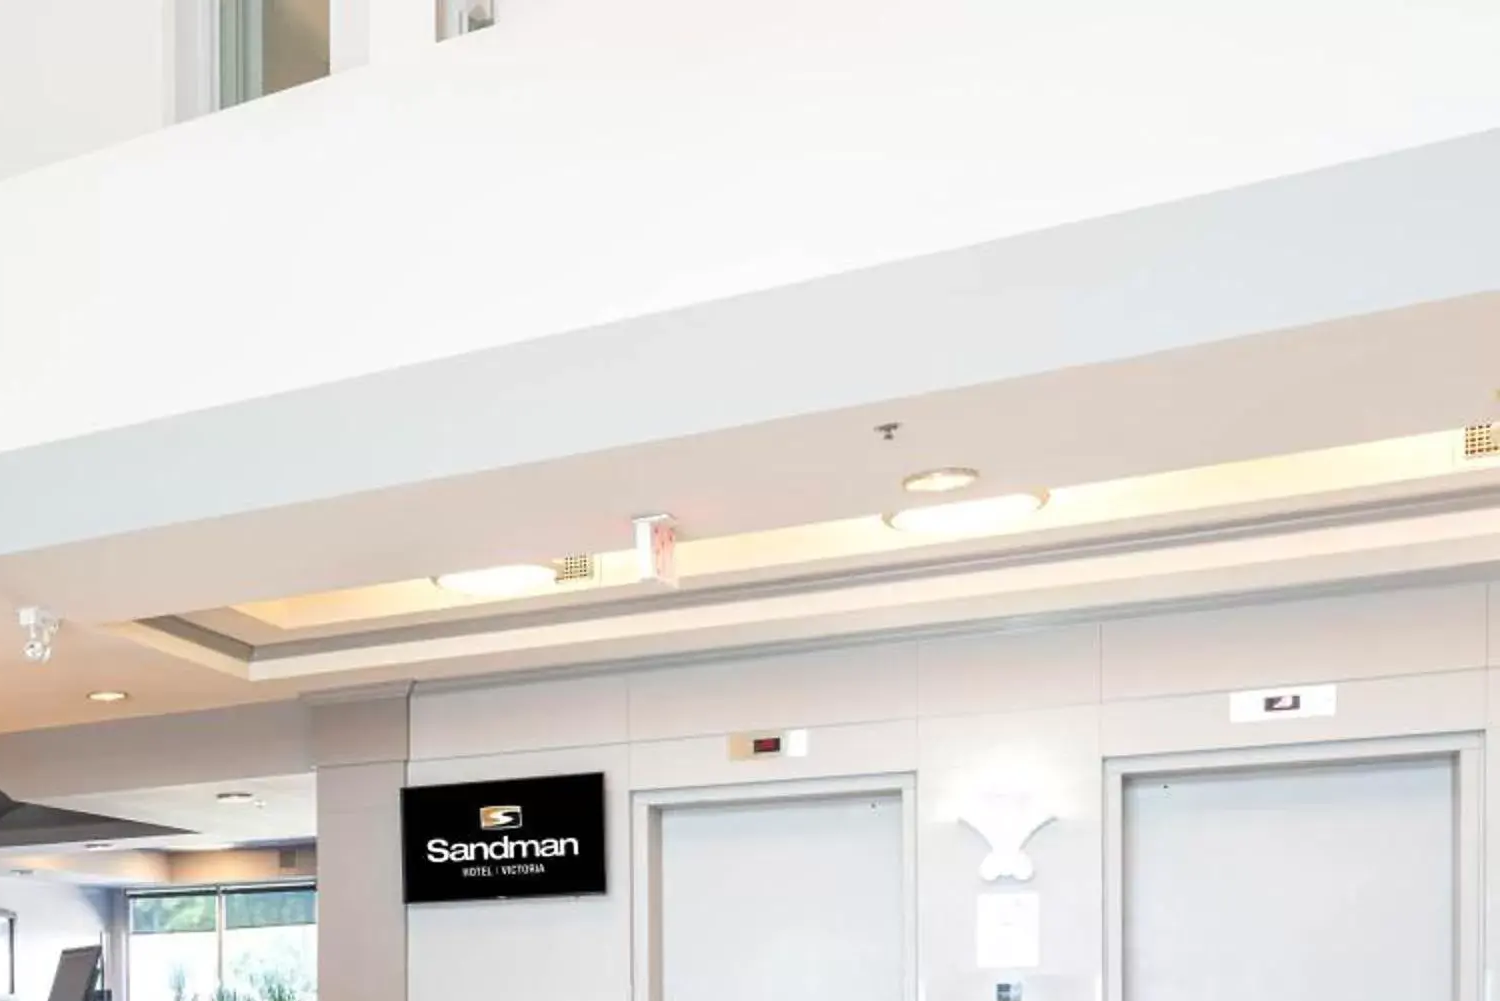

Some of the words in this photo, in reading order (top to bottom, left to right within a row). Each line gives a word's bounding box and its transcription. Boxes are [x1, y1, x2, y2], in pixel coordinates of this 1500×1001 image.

[426, 835, 580, 863] Sandman
[462, 865, 493, 877] HOTEL
[501, 863, 546, 875] VICTORIA
